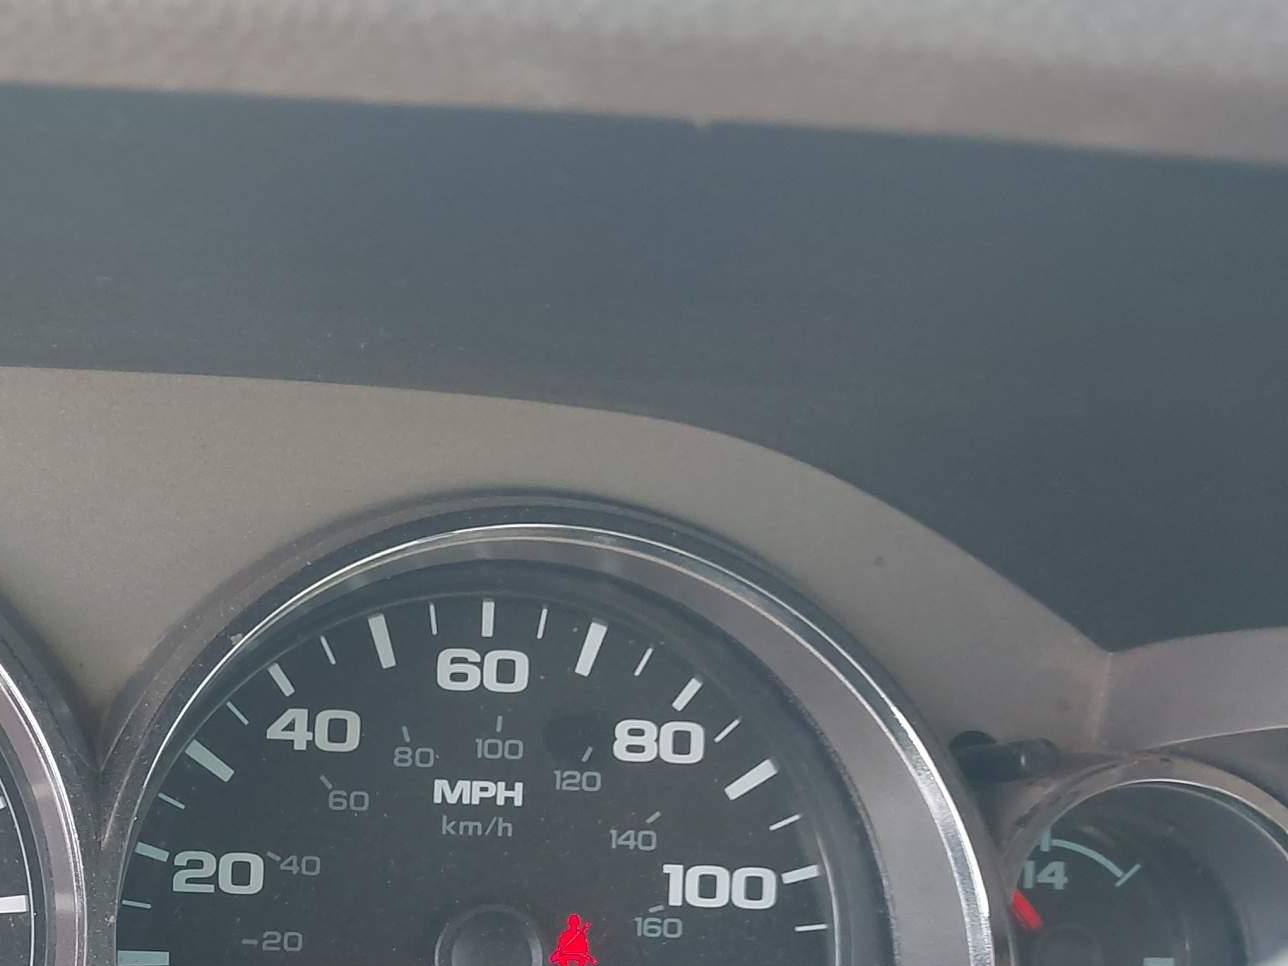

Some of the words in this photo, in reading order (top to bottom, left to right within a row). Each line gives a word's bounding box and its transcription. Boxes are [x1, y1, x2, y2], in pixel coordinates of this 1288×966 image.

[436, 650, 529, 692] 60
[267, 709, 361, 751] 40
[476, 738, 523, 759] 100
[613, 720, 704, 763] 80
[393, 746, 435, 768] 80
[554, 770, 602, 792] 120
[328, 790, 369, 811] 60
[433, 781, 524, 806] MPH
[441, 816, 513, 838] km/h
[610, 829, 657, 850] 140
[172, 851, 263, 894] 20
[279, 855, 321, 876] 40
[1021, 860, 1068, 890] 14
[663, 864, 777, 909] 100
[634, 917, 682, 938] 160
[261, 931, 303, 952] 20
